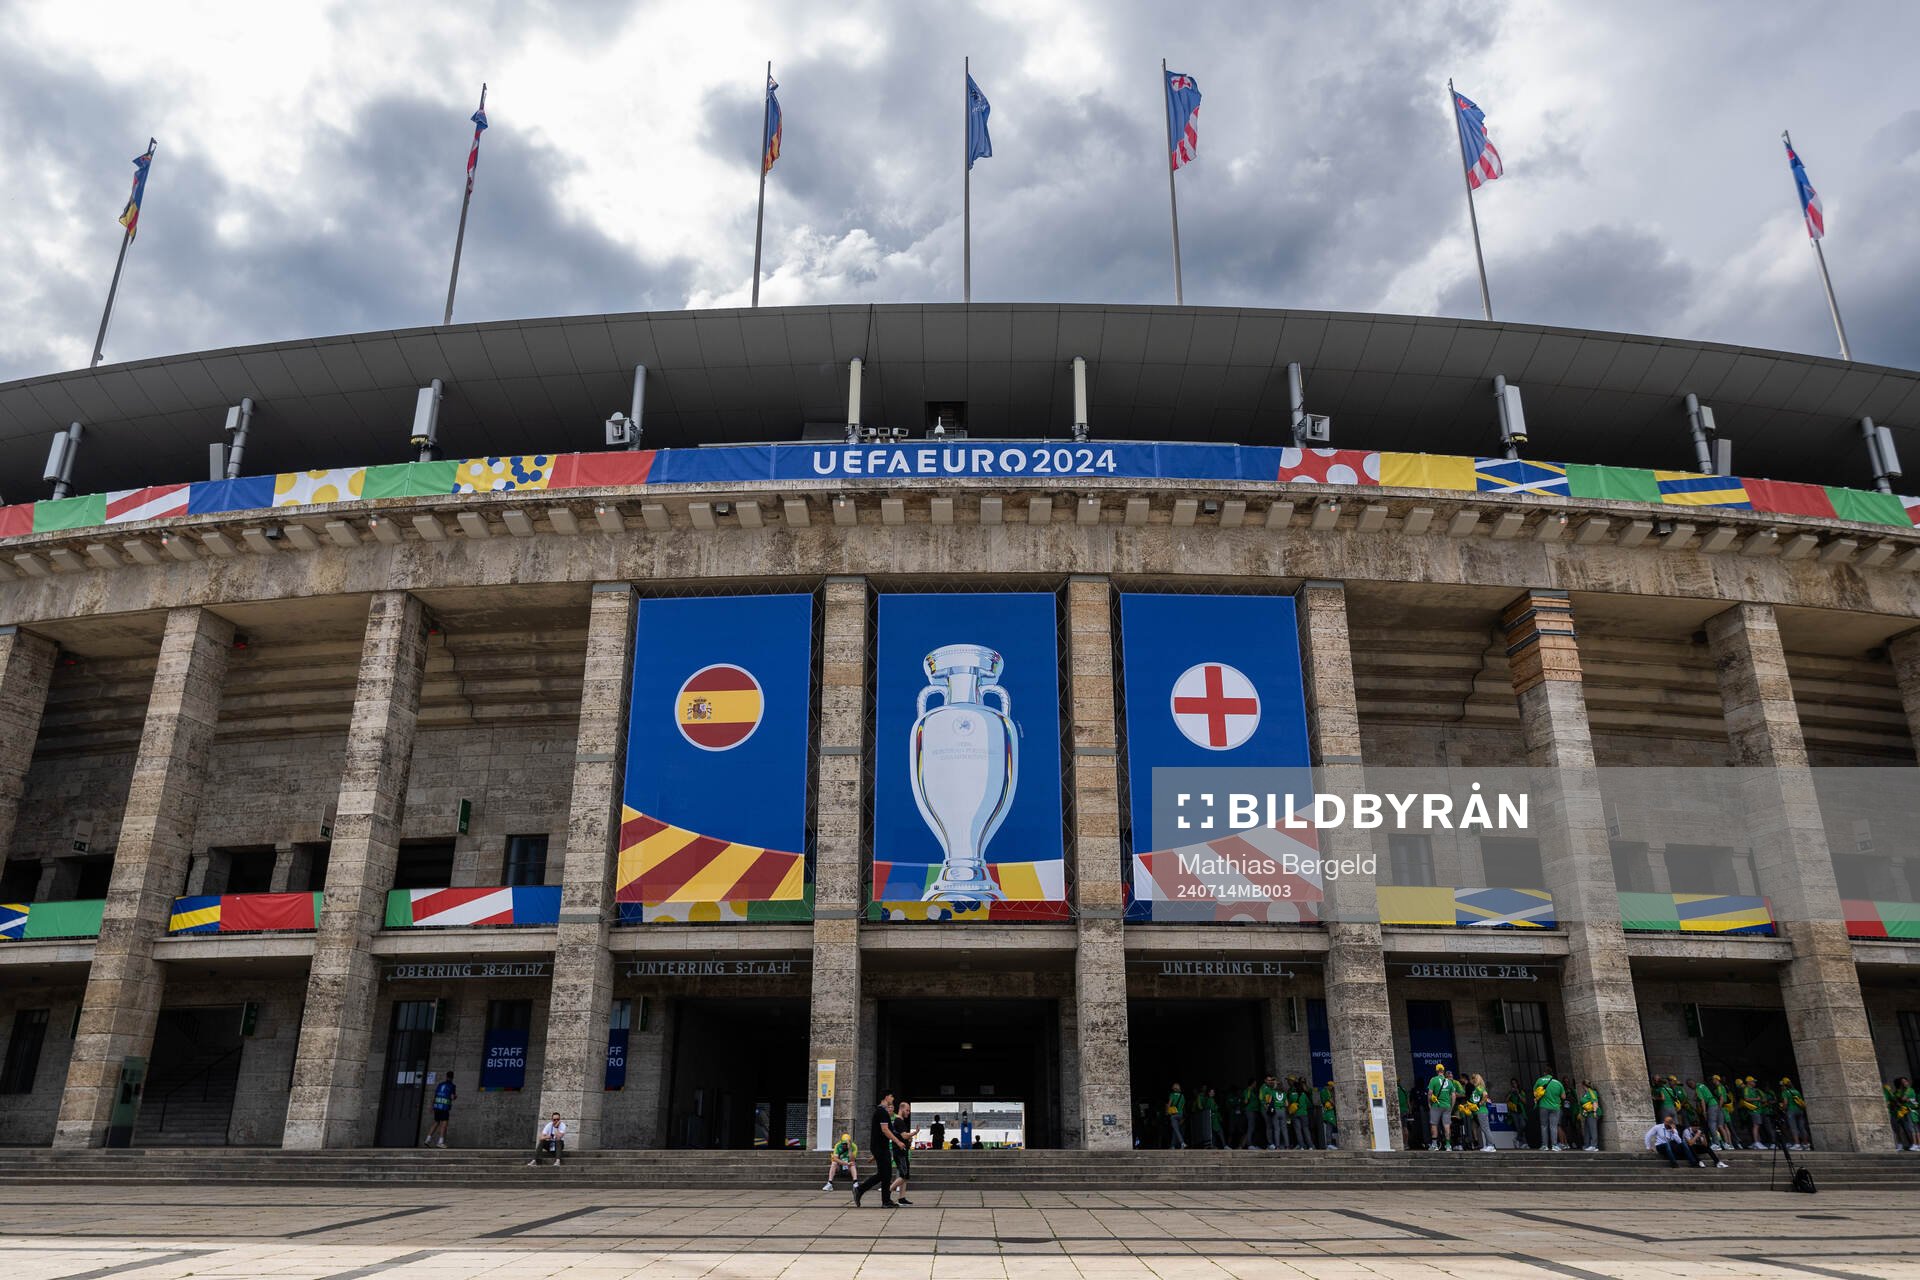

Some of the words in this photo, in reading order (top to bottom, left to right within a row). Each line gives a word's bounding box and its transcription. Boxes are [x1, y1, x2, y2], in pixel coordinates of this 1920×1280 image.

[813, 449, 911, 474] UEFA
[917, 448, 1027, 473] EURO
[1032, 449, 1117, 473] 2024
[396, 964, 472, 977] OBERRING
[636, 962, 725, 974] UNTERRING
[1163, 962, 1253, 974] UNTERRING
[1263, 963, 1282, 974] R-J
[1411, 964, 1488, 976] OBERRING
[1498, 966, 1528, 977] 37-18
[491, 1048, 522, 1056] STAFF
[487, 1058, 524, 1068] BISTRO
